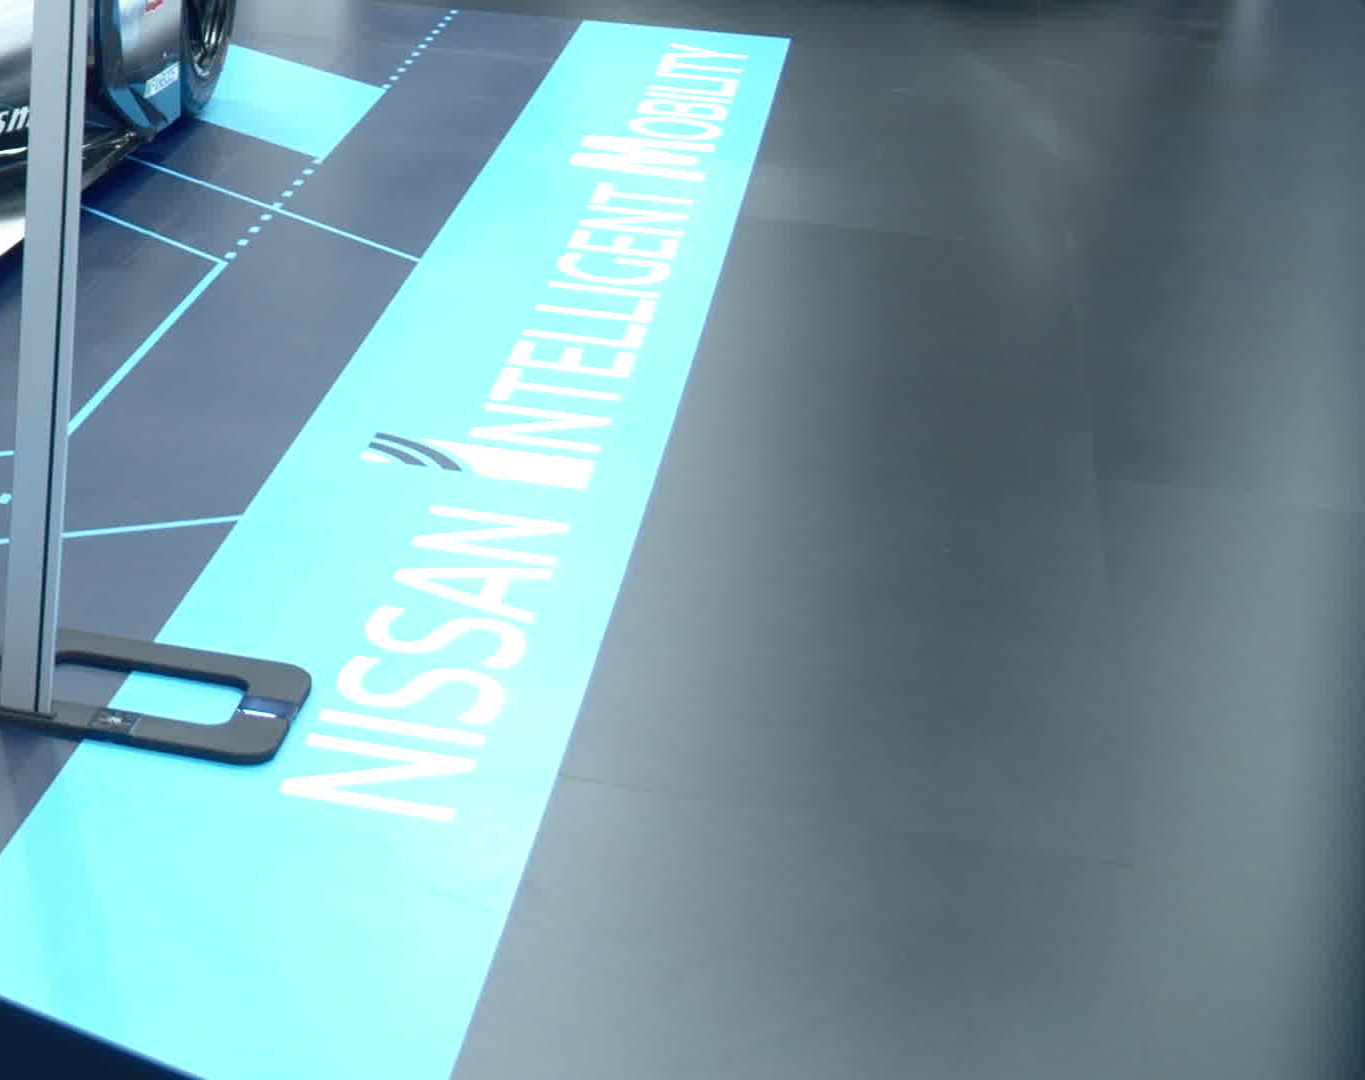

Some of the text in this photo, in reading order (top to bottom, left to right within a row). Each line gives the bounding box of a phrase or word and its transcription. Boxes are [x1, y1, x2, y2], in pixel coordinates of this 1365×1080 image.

[279, 41, 752, 823] NISSAN INTELLIGENT MOBILITY
